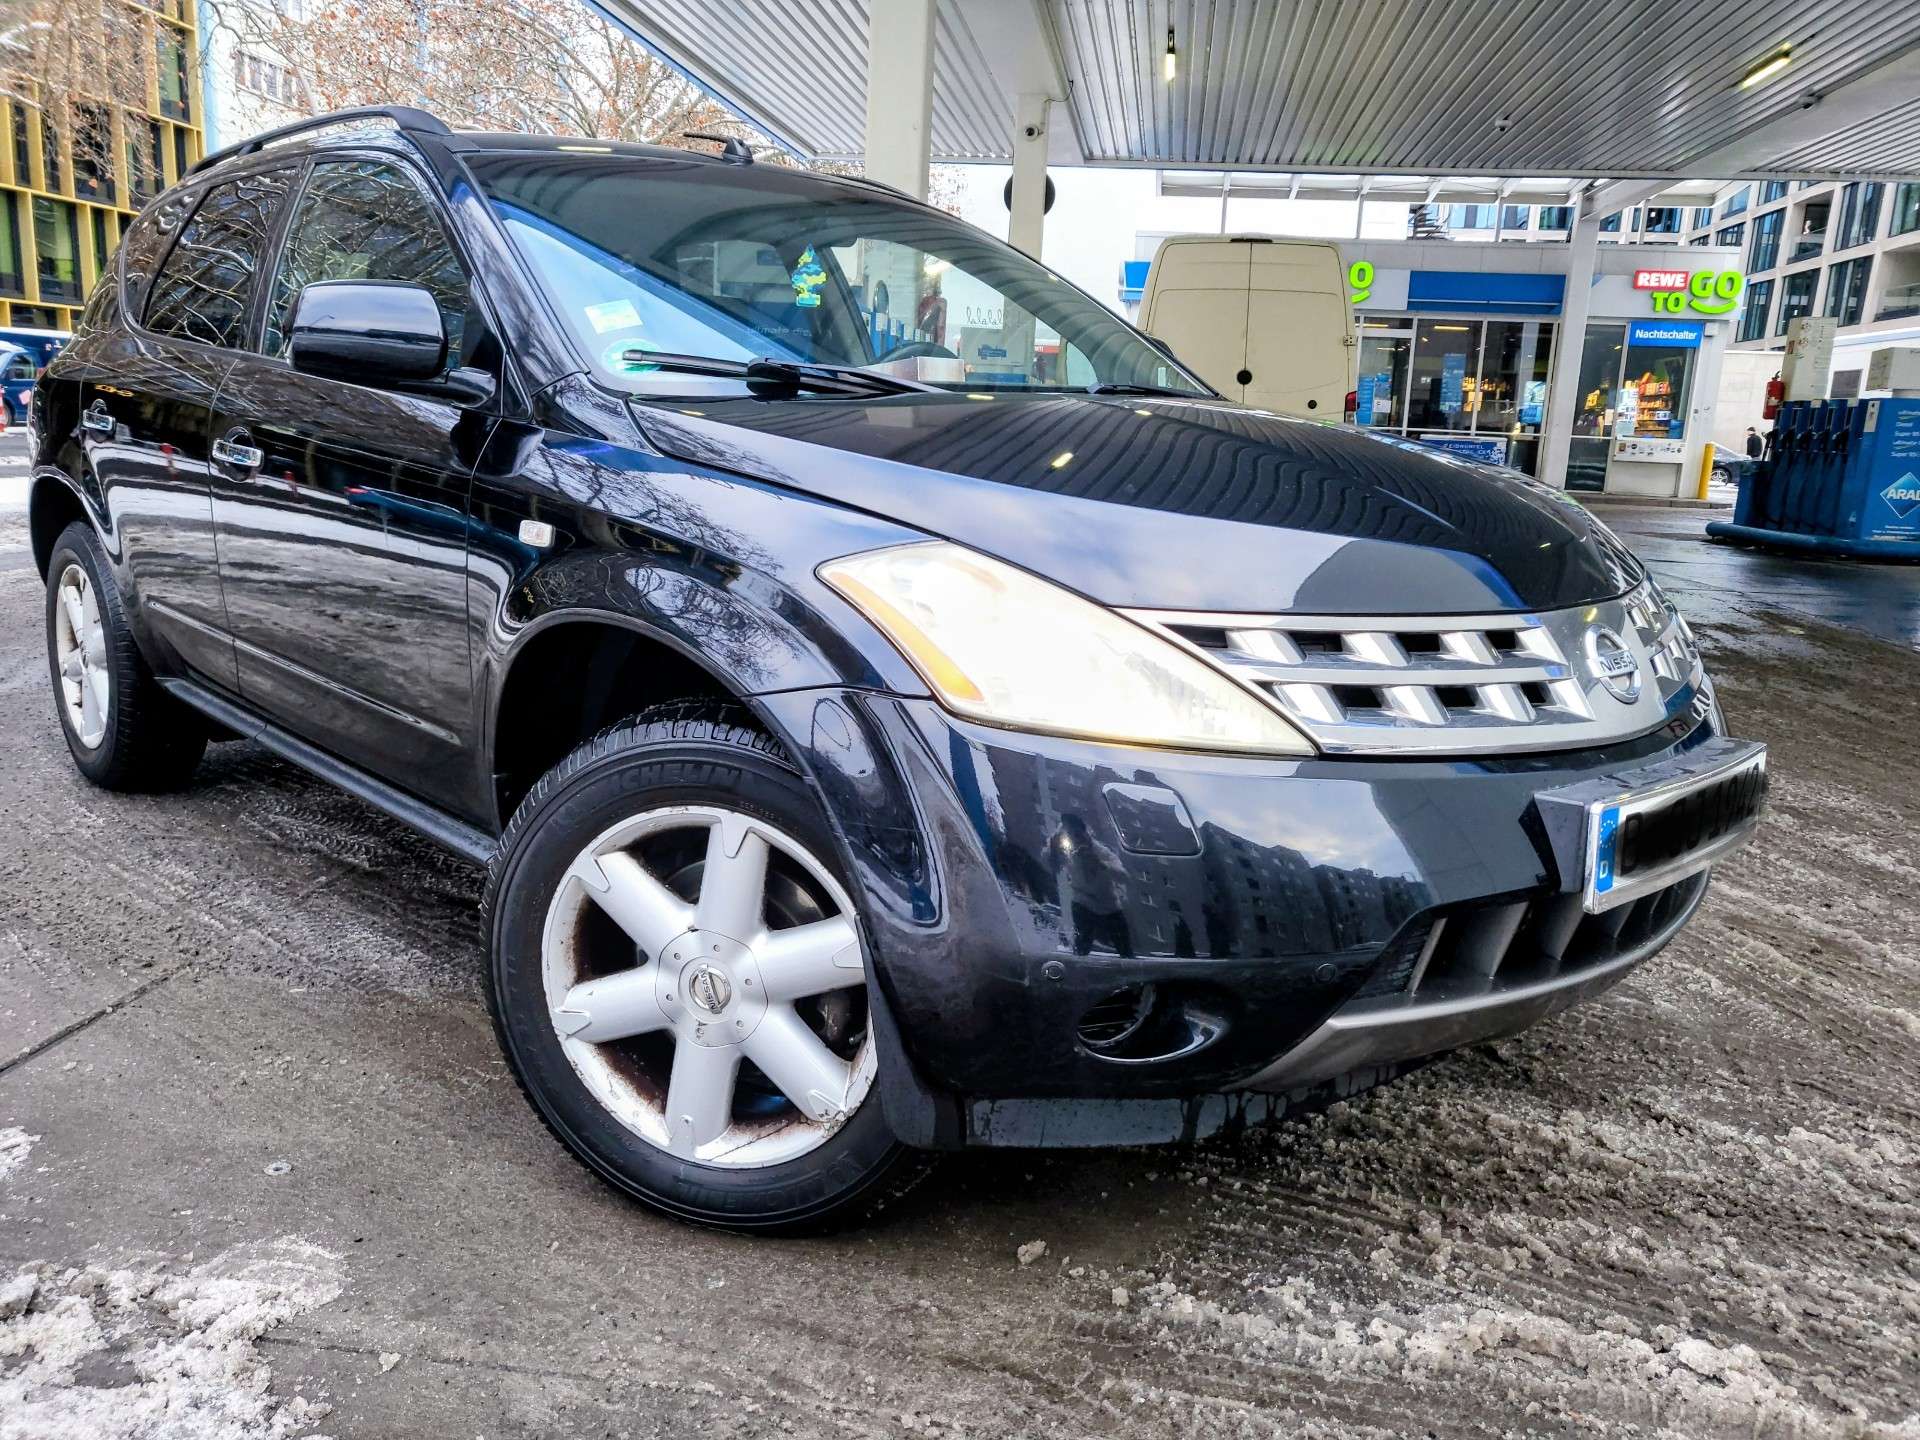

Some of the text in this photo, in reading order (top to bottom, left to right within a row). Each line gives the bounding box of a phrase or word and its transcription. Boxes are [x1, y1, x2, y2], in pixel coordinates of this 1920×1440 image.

[1348, 261, 1375, 290] O
[1637, 272, 1686, 288] REWE
[1652, 270, 1743, 313] TO GO
[1635, 329, 1698, 340] Nachtschalter
[1600, 654, 1638, 672] NISSA
[1599, 860, 1609, 879] D
[697, 967, 719, 1010] NISSAN
